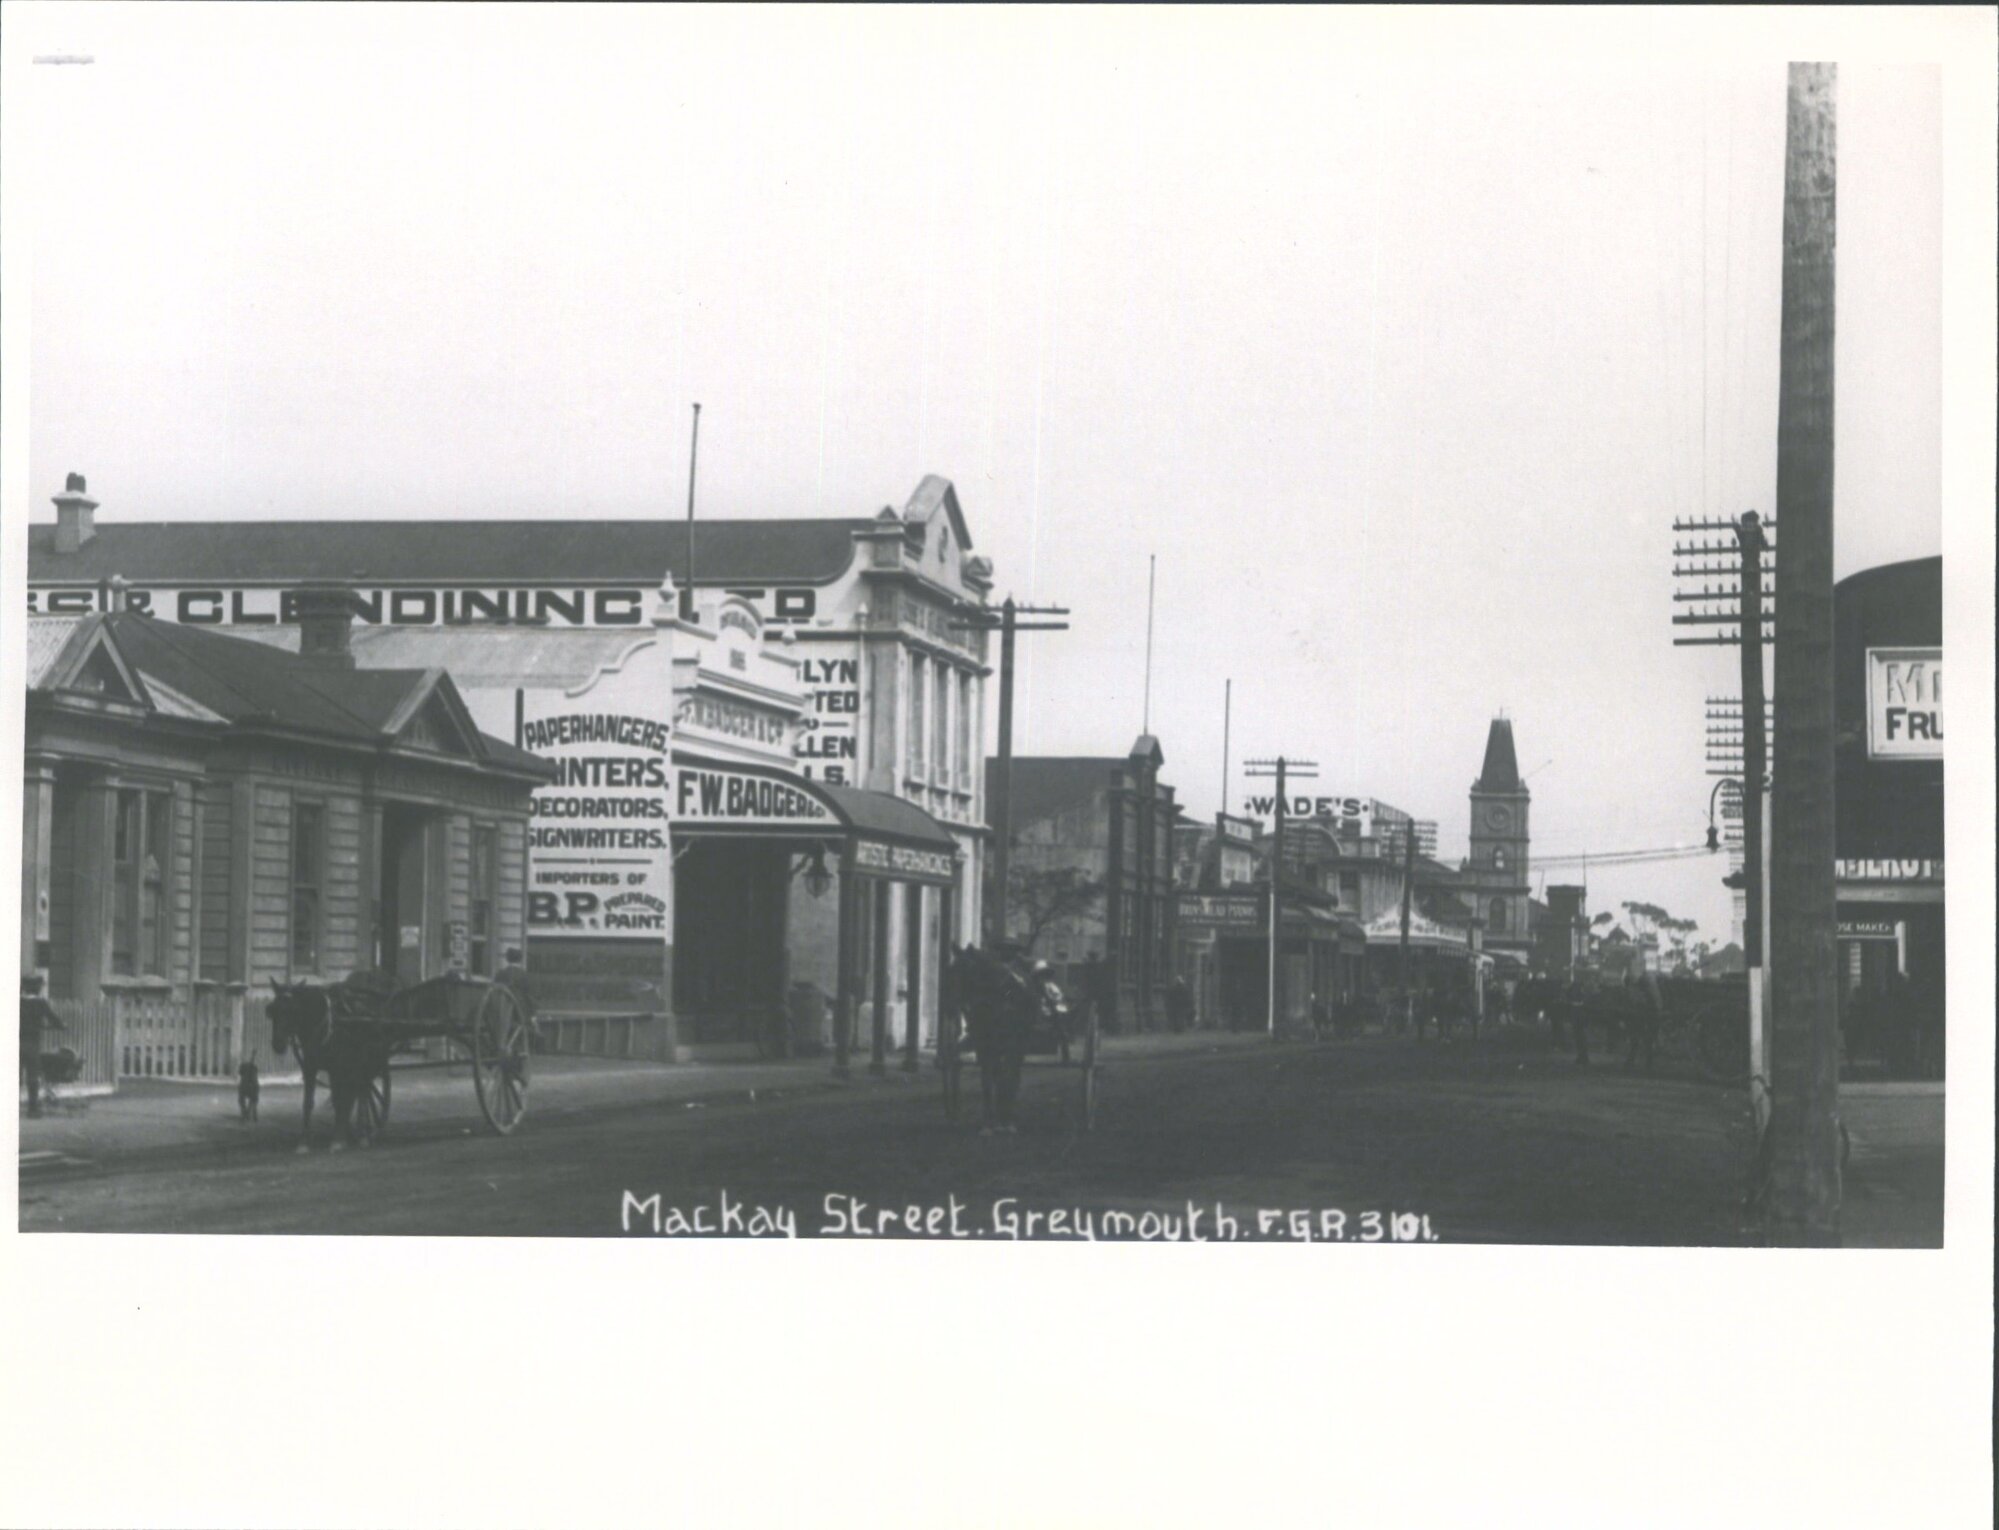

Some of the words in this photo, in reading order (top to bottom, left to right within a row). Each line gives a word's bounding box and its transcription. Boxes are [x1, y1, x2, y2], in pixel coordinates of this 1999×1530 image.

[797, 659, 858, 683] LYN
[524, 713, 670, 756] PAPERHANGERS,
[528, 797, 669, 820] DECORATORS,
[528, 827, 667, 850] SIGNWRITERS.
[536, 871, 621, 886] IMPORTERS
[627, 871, 648, 887] OF
[603, 890, 667, 914] PREPARED
[604, 913, 666, 930] PAINT.
